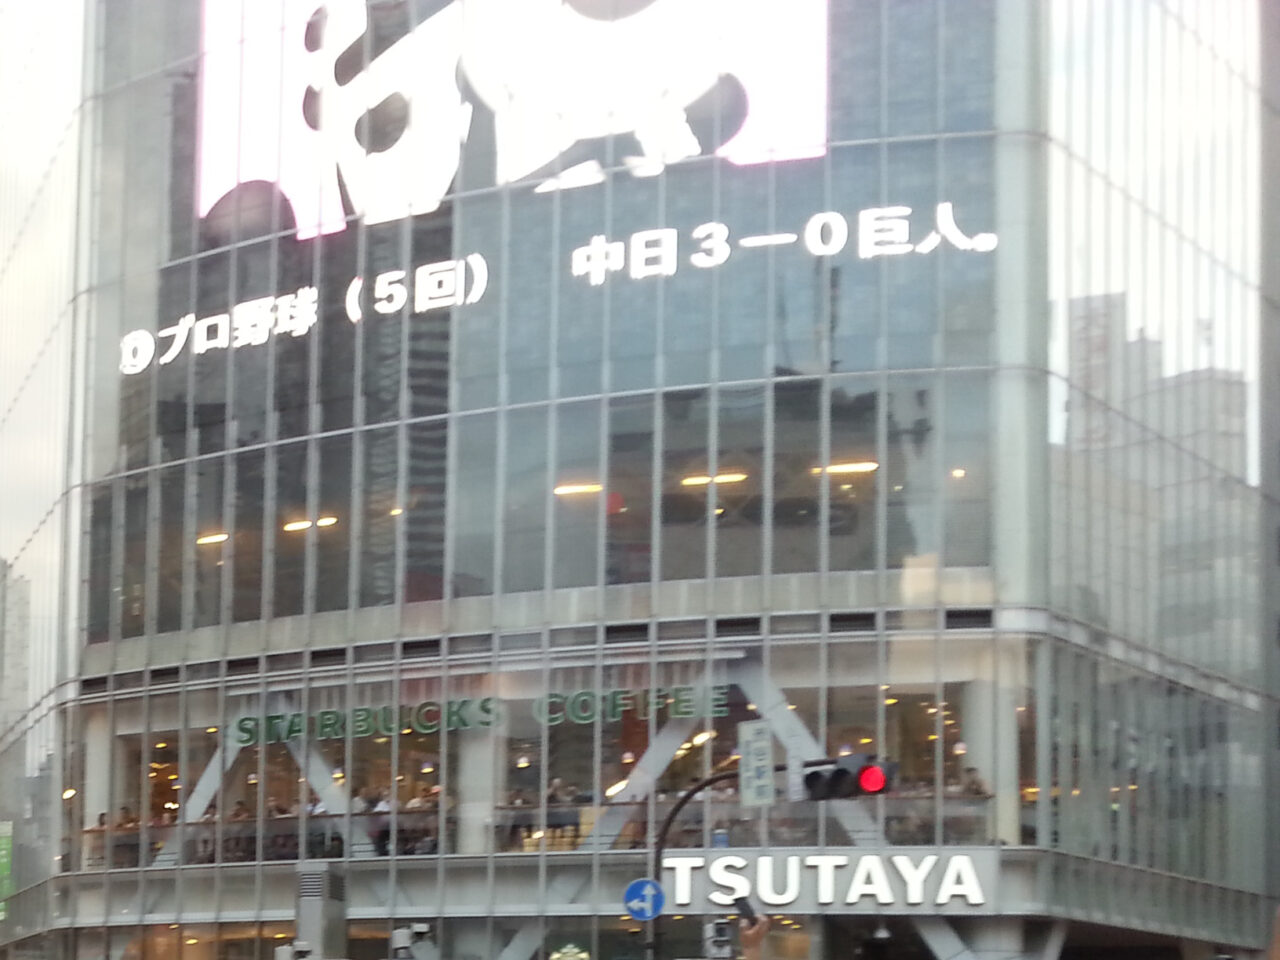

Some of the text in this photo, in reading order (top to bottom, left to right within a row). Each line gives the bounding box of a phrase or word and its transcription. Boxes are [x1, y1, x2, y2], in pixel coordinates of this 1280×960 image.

[234, 683, 731, 748] STARBUCKS COFFEE
[662, 855, 985, 906] TSUTAYA
